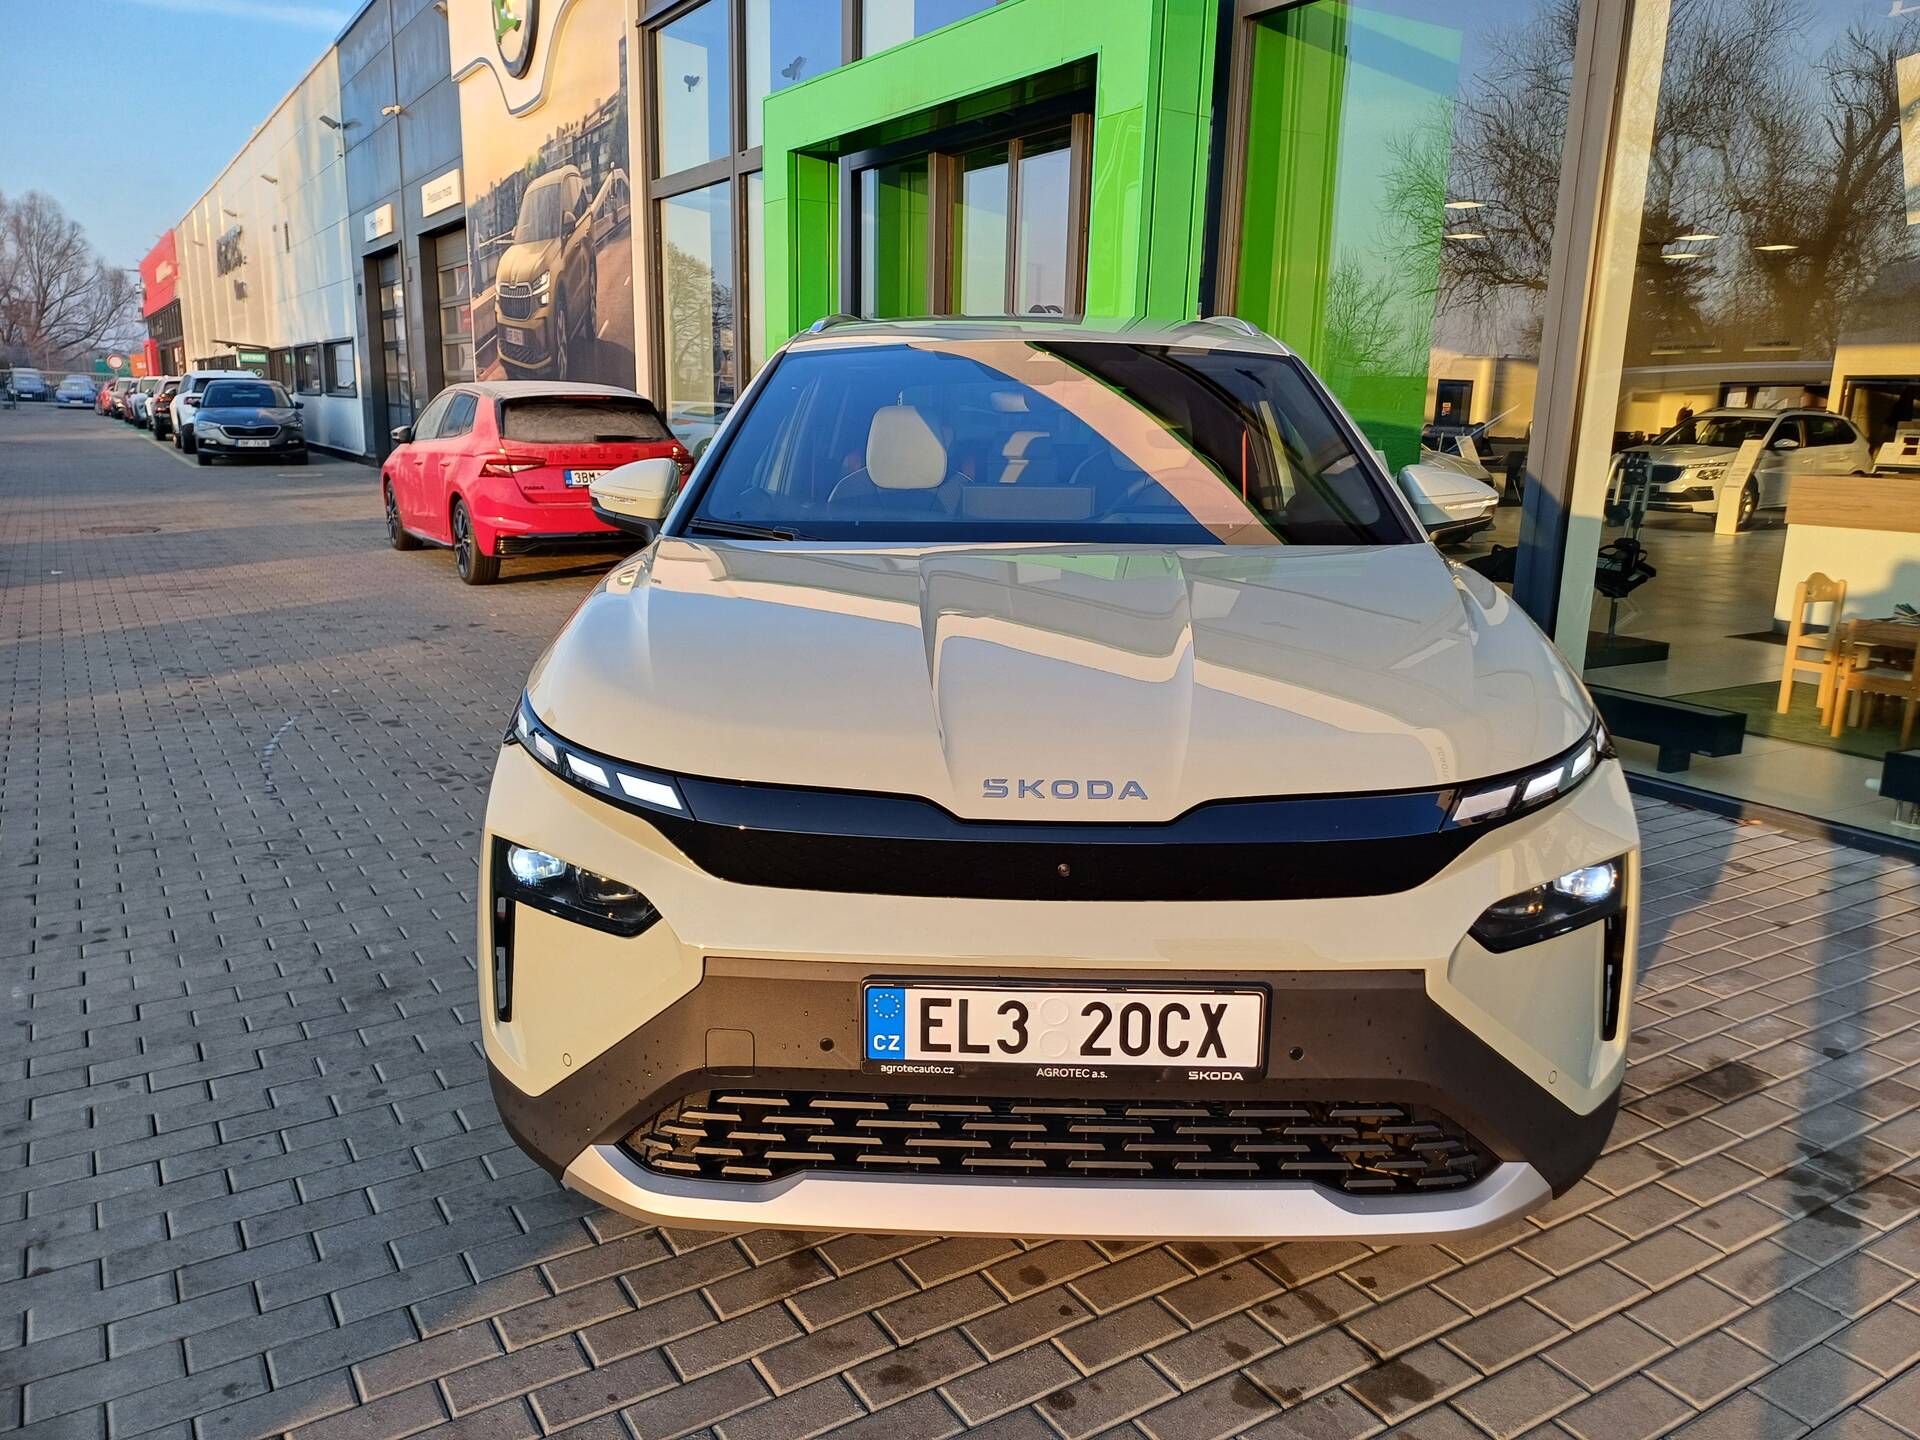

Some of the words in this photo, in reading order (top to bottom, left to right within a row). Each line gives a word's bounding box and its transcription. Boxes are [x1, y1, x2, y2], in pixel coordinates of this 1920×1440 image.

[919, 997, 1029, 1055] EL3
[1079, 1001, 1229, 1059] 20CX
[873, 1034, 901, 1052] CZ
[880, 1063, 955, 1075] agrotecauto.cz
[1036, 1066, 1090, 1078] AGROTEC
[1092, 1069, 1108, 1079] a.s.
